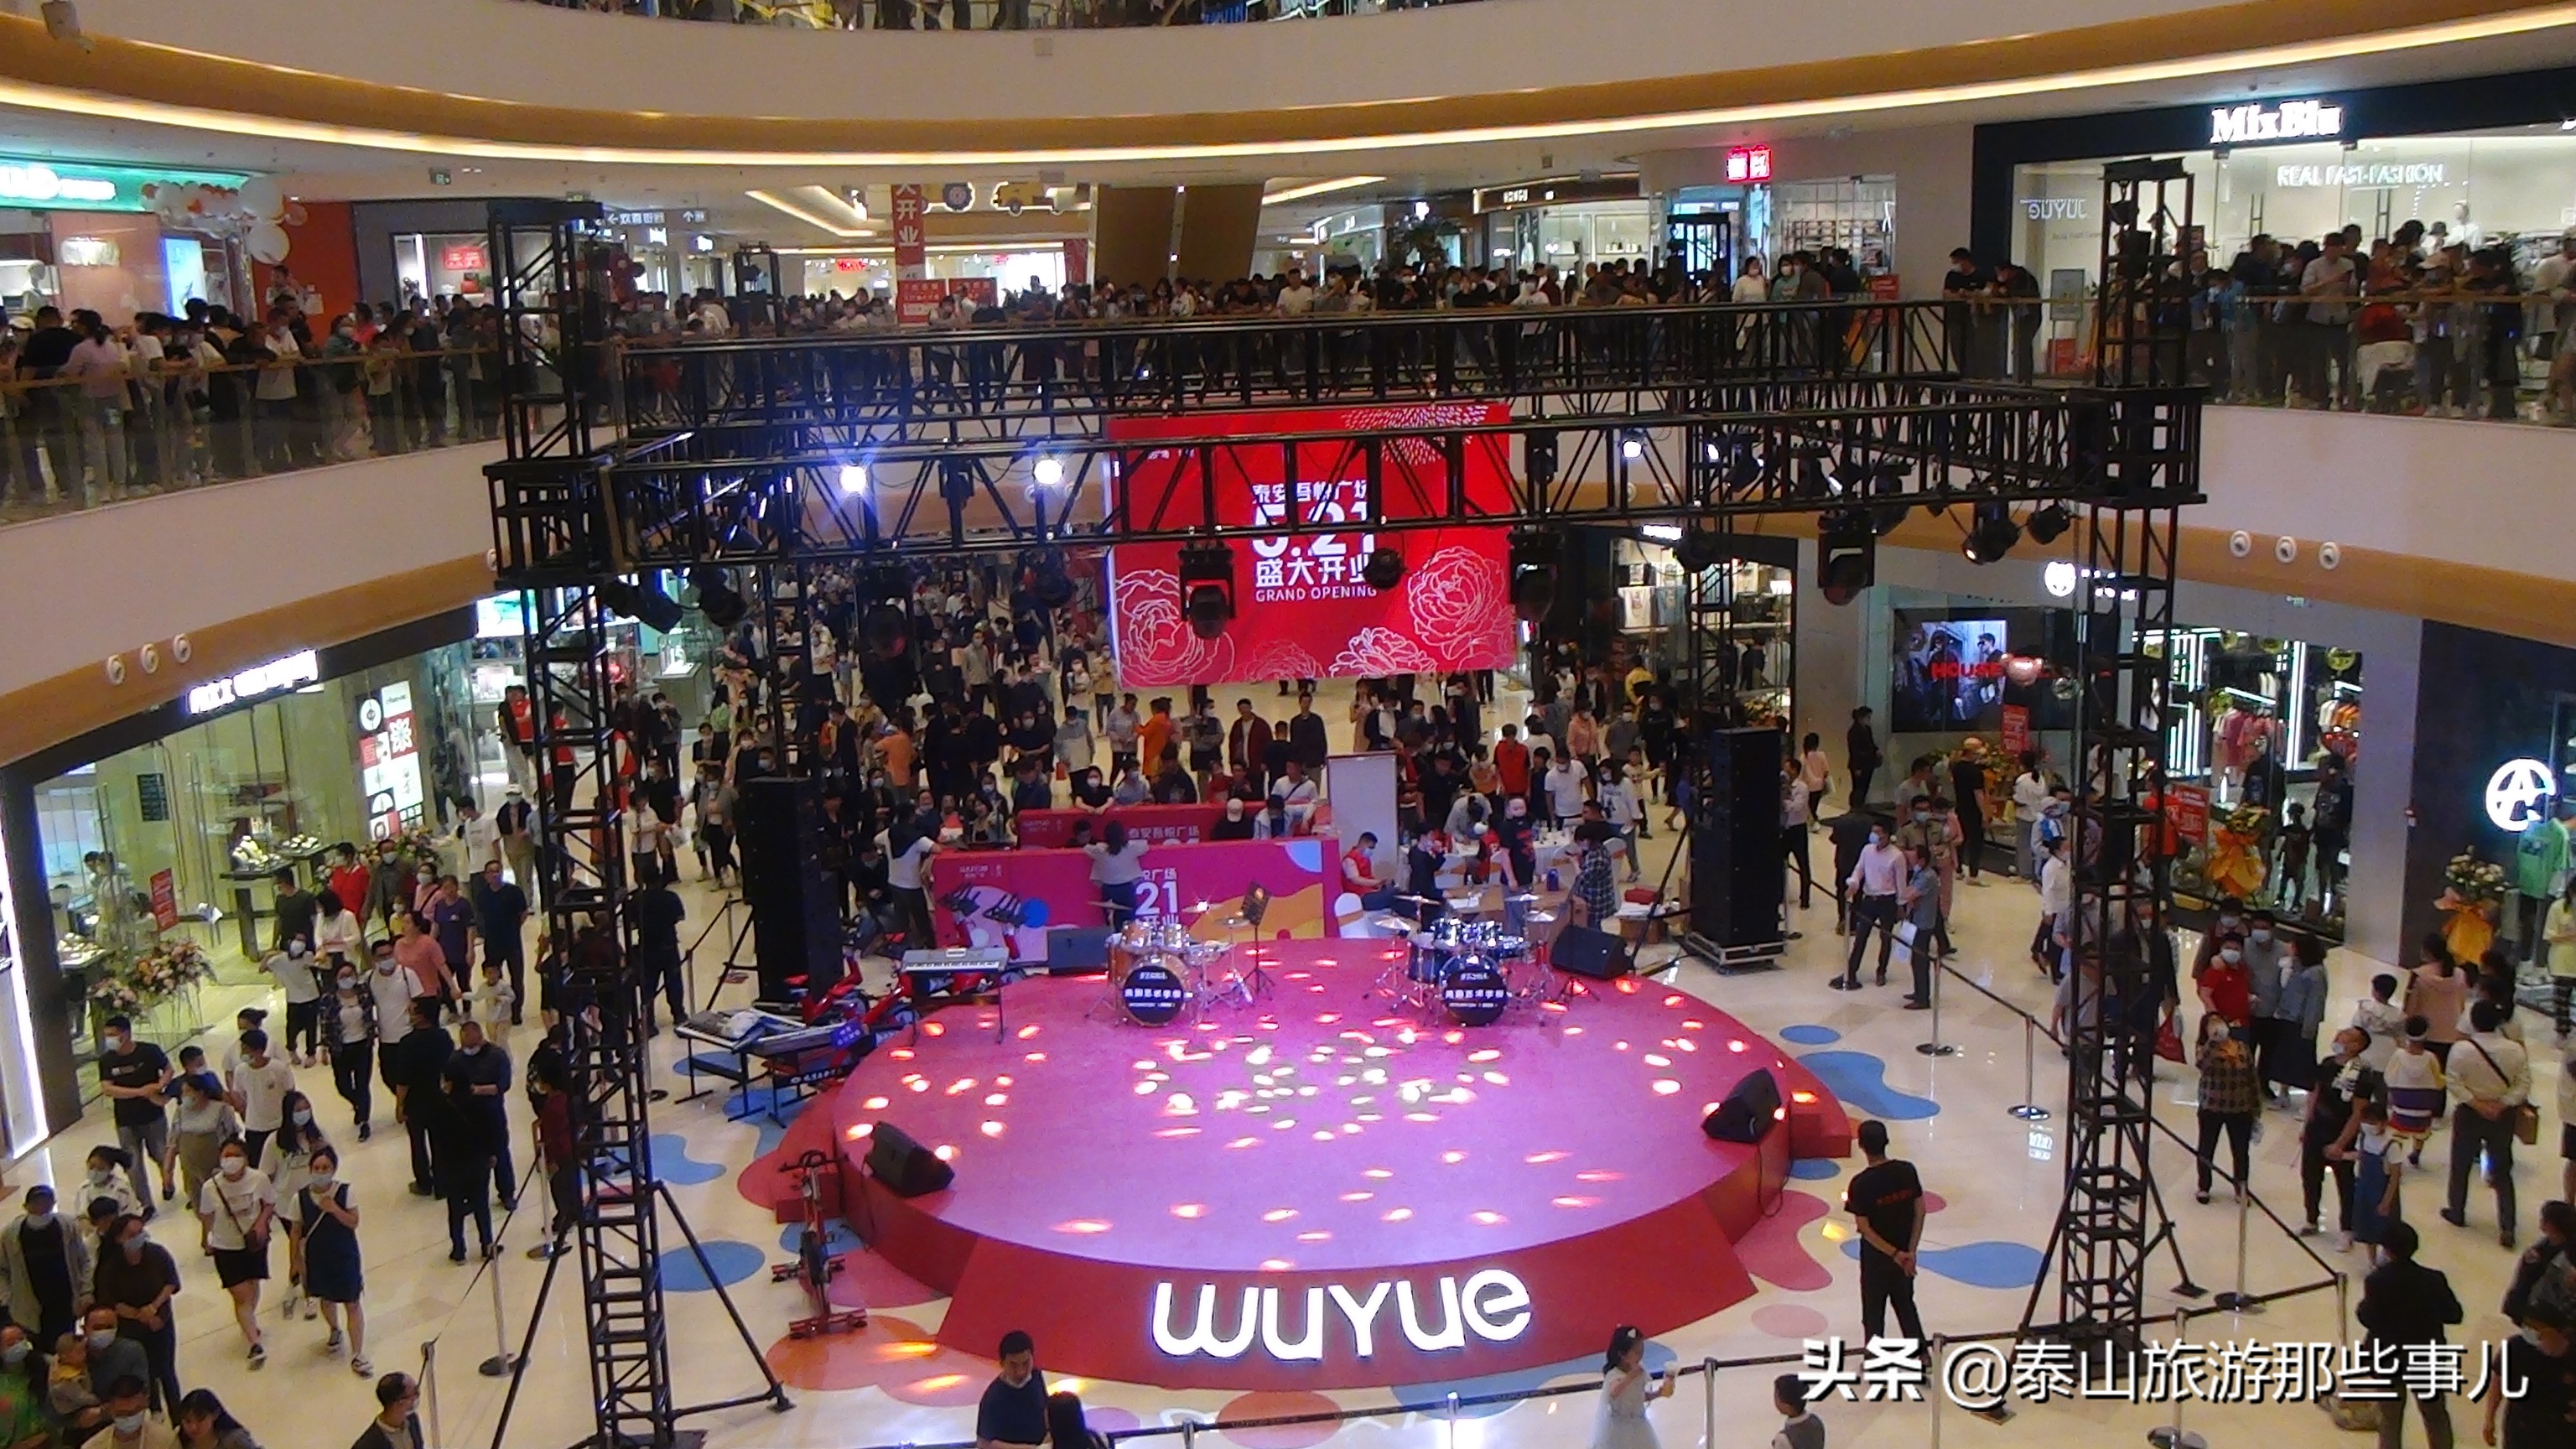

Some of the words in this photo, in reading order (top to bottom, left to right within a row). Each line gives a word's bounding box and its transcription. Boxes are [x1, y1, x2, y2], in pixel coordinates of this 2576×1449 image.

[2277, 164, 2321, 186] REAL
[1255, 589, 1306, 602] GRAND
[1311, 585, 1377, 600] OPENING
